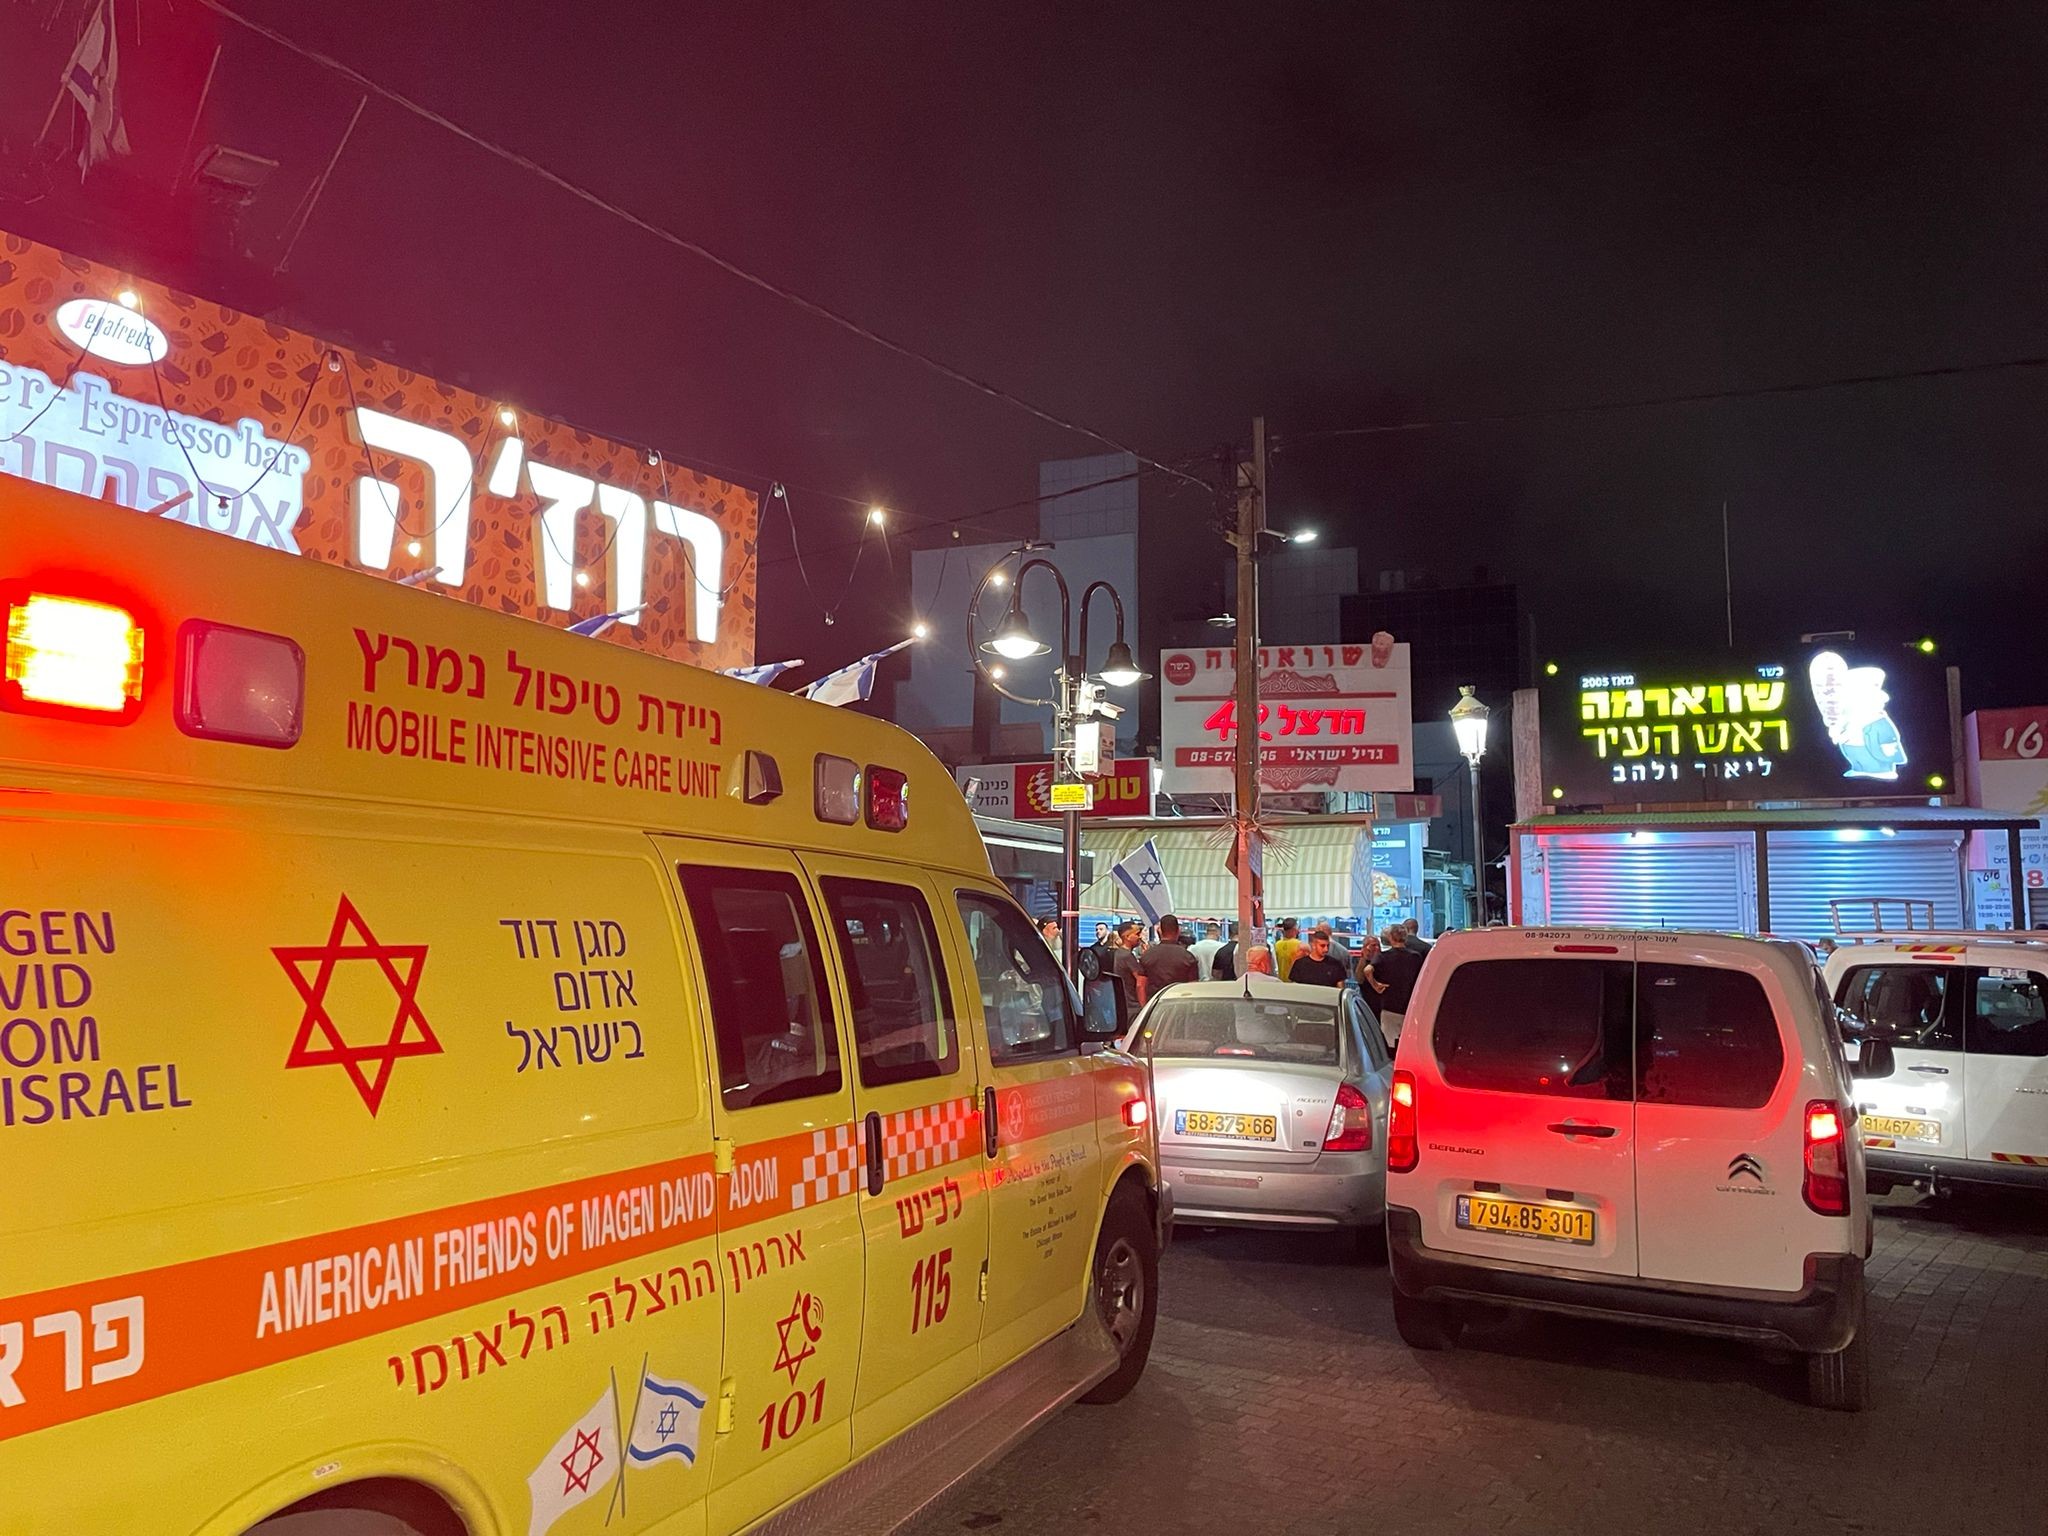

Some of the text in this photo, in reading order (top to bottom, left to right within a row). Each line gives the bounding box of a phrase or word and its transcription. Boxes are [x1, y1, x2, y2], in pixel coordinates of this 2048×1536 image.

[79, 382, 232, 460] Espresso
[244, 426, 300, 477] bar
[1205, 646, 1363, 670] שווארה
[1757, 666, 1784, 678] כשר
[353, 628, 721, 746] ניידת טיפול נמרץ
[1581, 681, 1786, 720] שווארמה
[1582, 677, 1610, 688] 2005
[1277, 703, 1367, 736] הרצל
[1582, 720, 1789, 759] ראש העיר
[347, 701, 721, 800] MOBILE INTENSIVE CARE UNIT
[1290, 748, 1346, 763] ישראלי
[1352, 747, 1384, 760] גריל
[2026, 868, 2045, 889] 8
[0, 910, 116, 956] GEN
[499, 920, 626, 966] מגן דוד
[0, 963, 92, 1011] VID
[553, 969, 638, 1012] אדום
[0, 1016, 100, 1068] OM
[505, 1020, 645, 1073] בישראל
[1, 1063, 192, 1126] ISRAEL
[1429, 1143, 1485, 1155] BERLINGO
[895, 1176, 962, 1239] לכיש
[256, 1157, 779, 1339] AMERICAN FRIENDS OF MAGEN DAVID ADOM
[387, 1229, 806, 1396] ארגון ההצלה הלאומי
[911, 1247, 952, 1335] 115
[758, 1378, 826, 1452] 101
